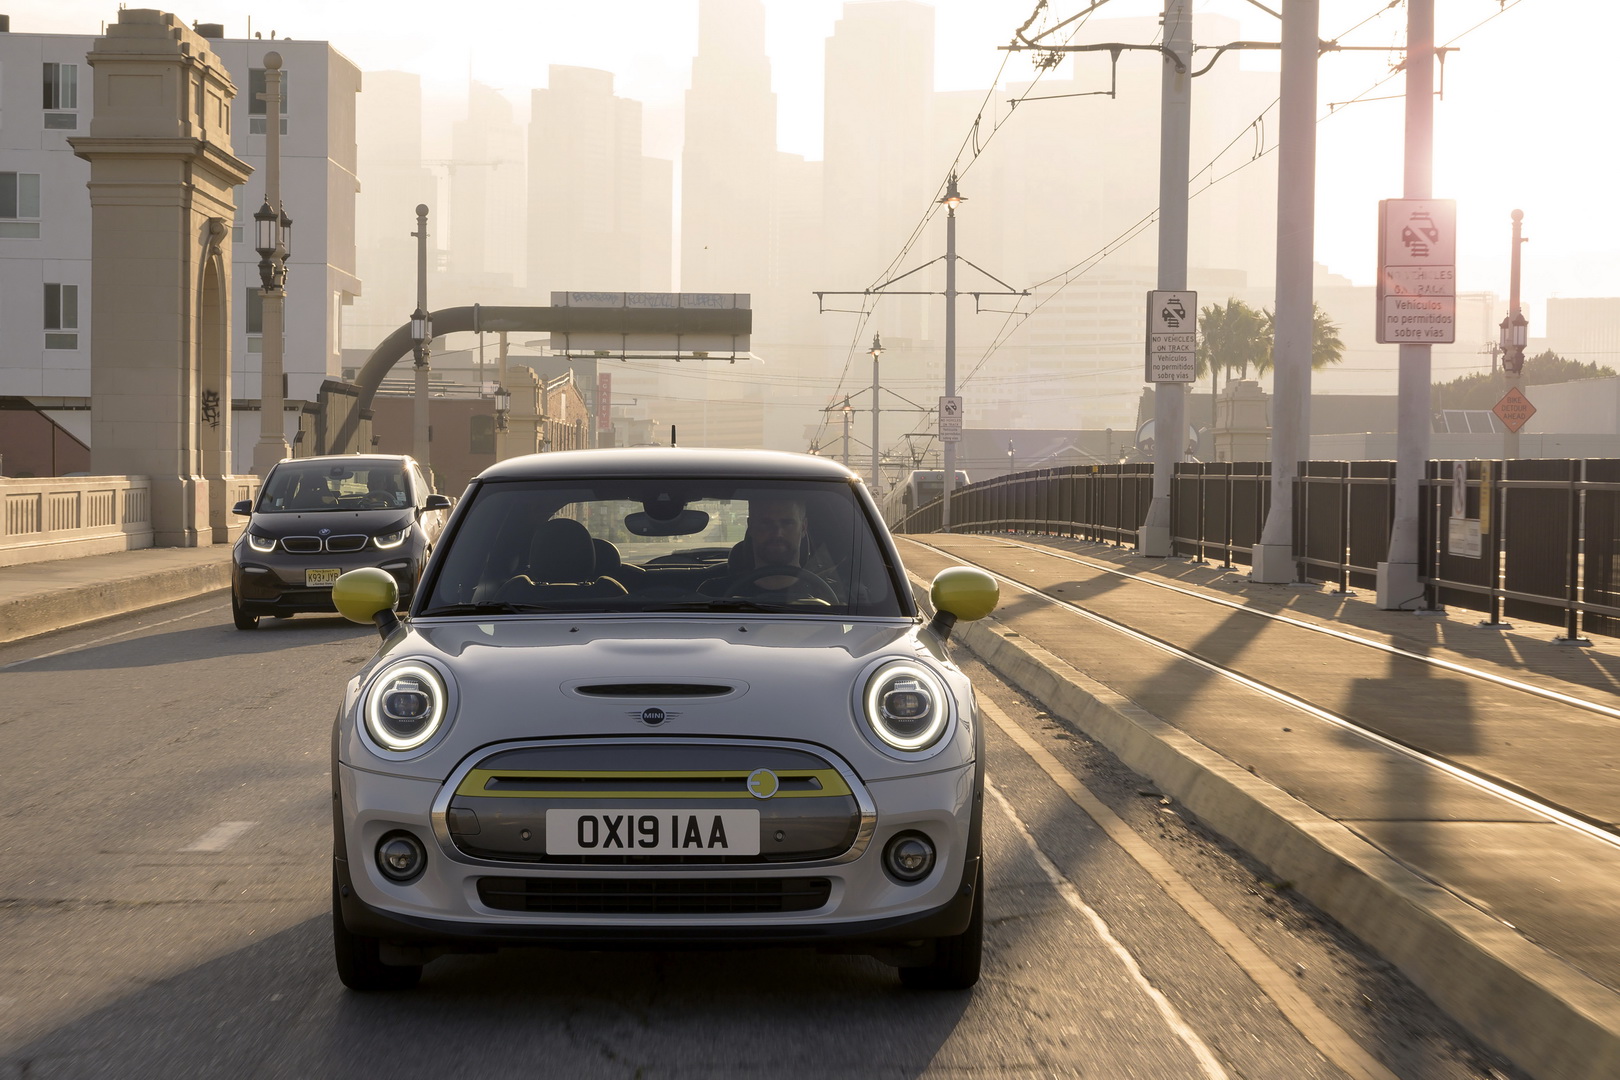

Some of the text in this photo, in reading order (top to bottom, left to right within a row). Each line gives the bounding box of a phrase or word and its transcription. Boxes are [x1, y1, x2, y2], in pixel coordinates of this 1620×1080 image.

[1404, 271, 1452, 280] EHLES
[1413, 284, 1446, 294] RACK
[1395, 300, 1442, 310] Vehículos
[1387, 314, 1452, 326] no permitidos
[1394, 327, 1444, 337] sobre vías
[1161, 363, 1194, 371] permitidos
[308, 573, 322, 582] K93
[577, 815, 660, 848] OX19
